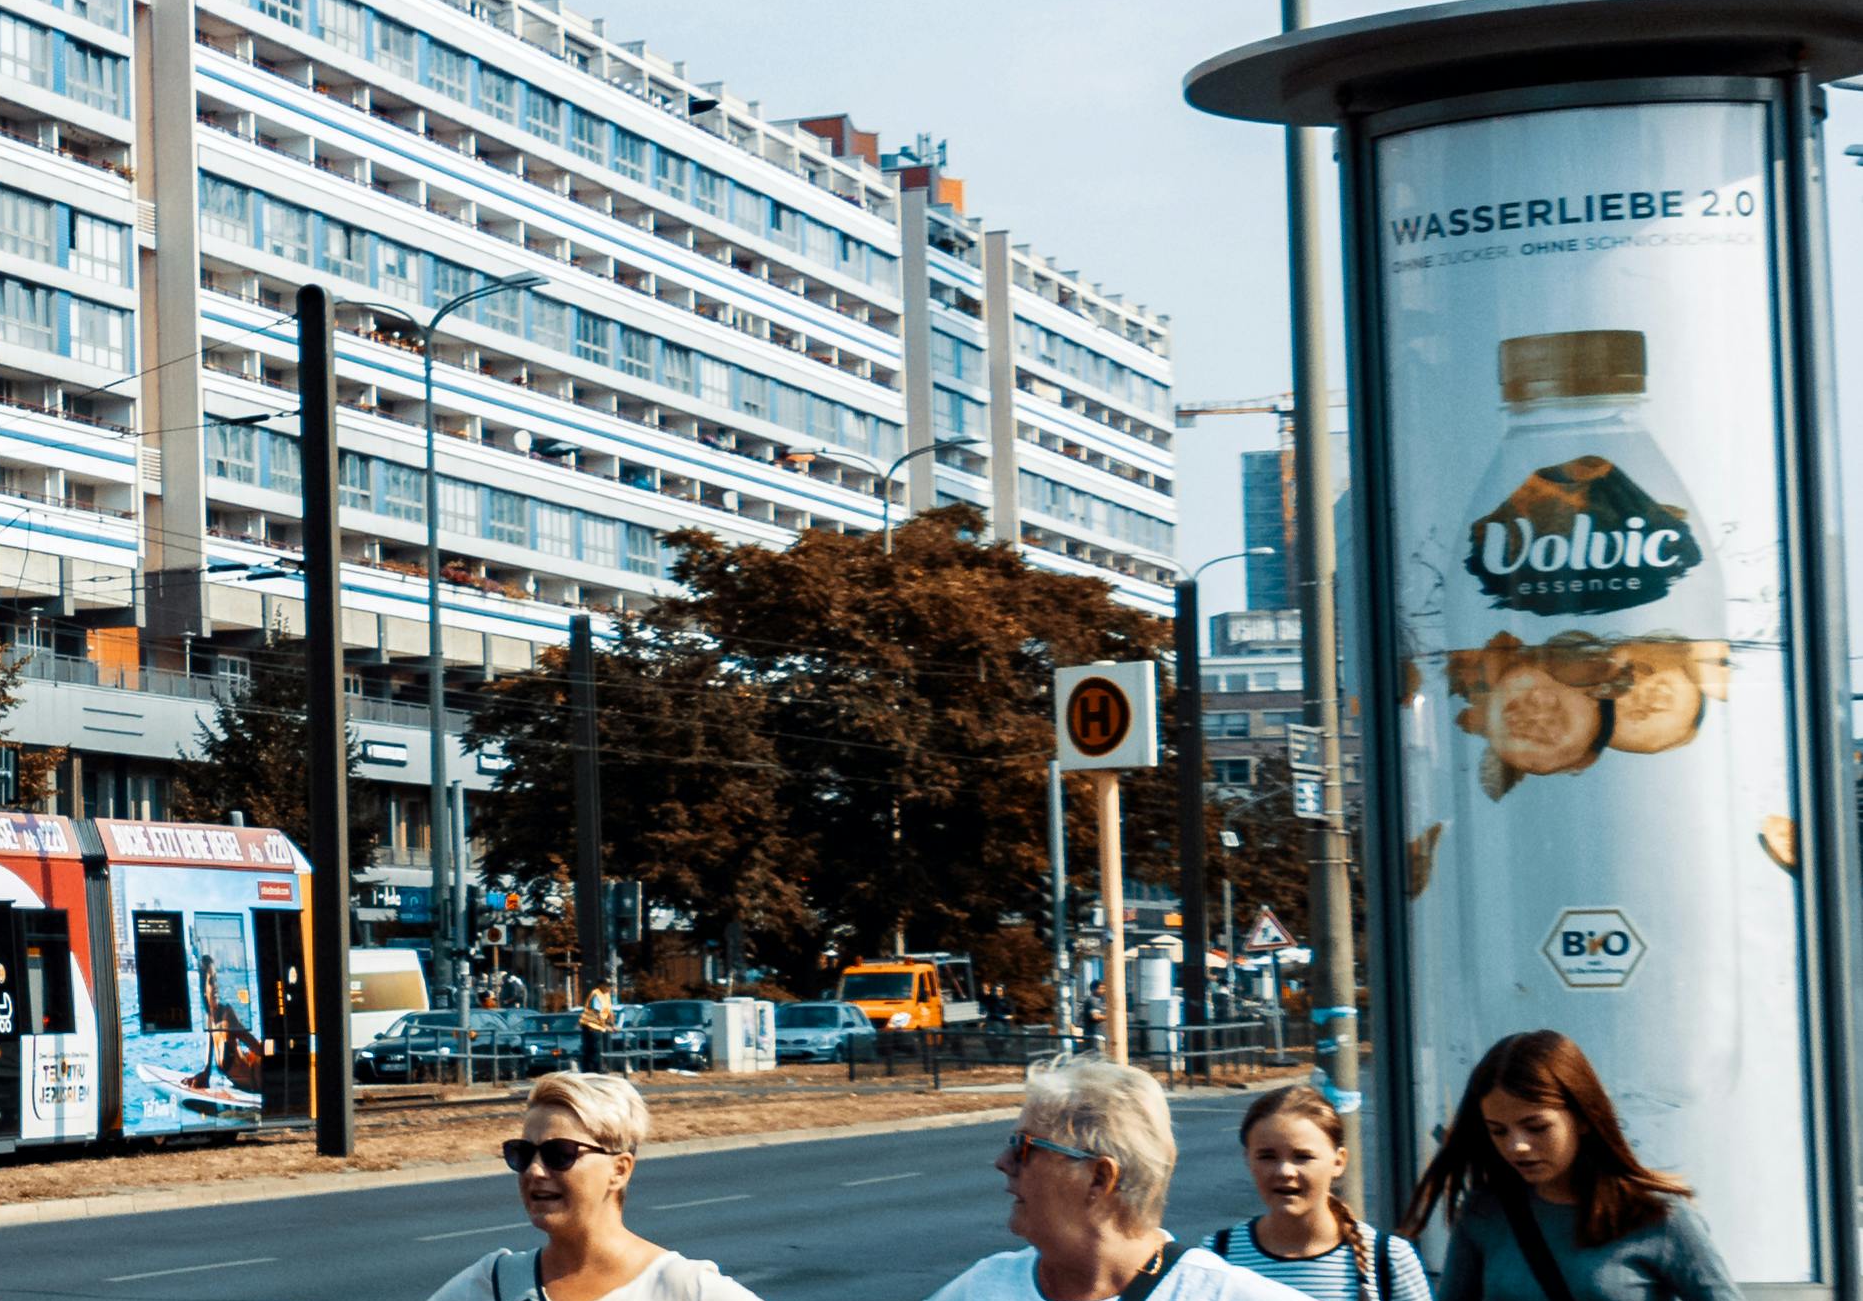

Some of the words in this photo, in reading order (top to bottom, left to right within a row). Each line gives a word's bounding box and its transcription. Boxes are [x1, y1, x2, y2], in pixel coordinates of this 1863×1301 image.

[1391, 191, 1683, 245] WASSERLIEBE
[1700, 190, 1754, 217] 2.0
[1521, 239, 1577, 255] OHNE
[1482, 513, 1681, 575] Volvic
[1518, 577, 1642, 595] essence
[1080, 695, 1111, 739] H
